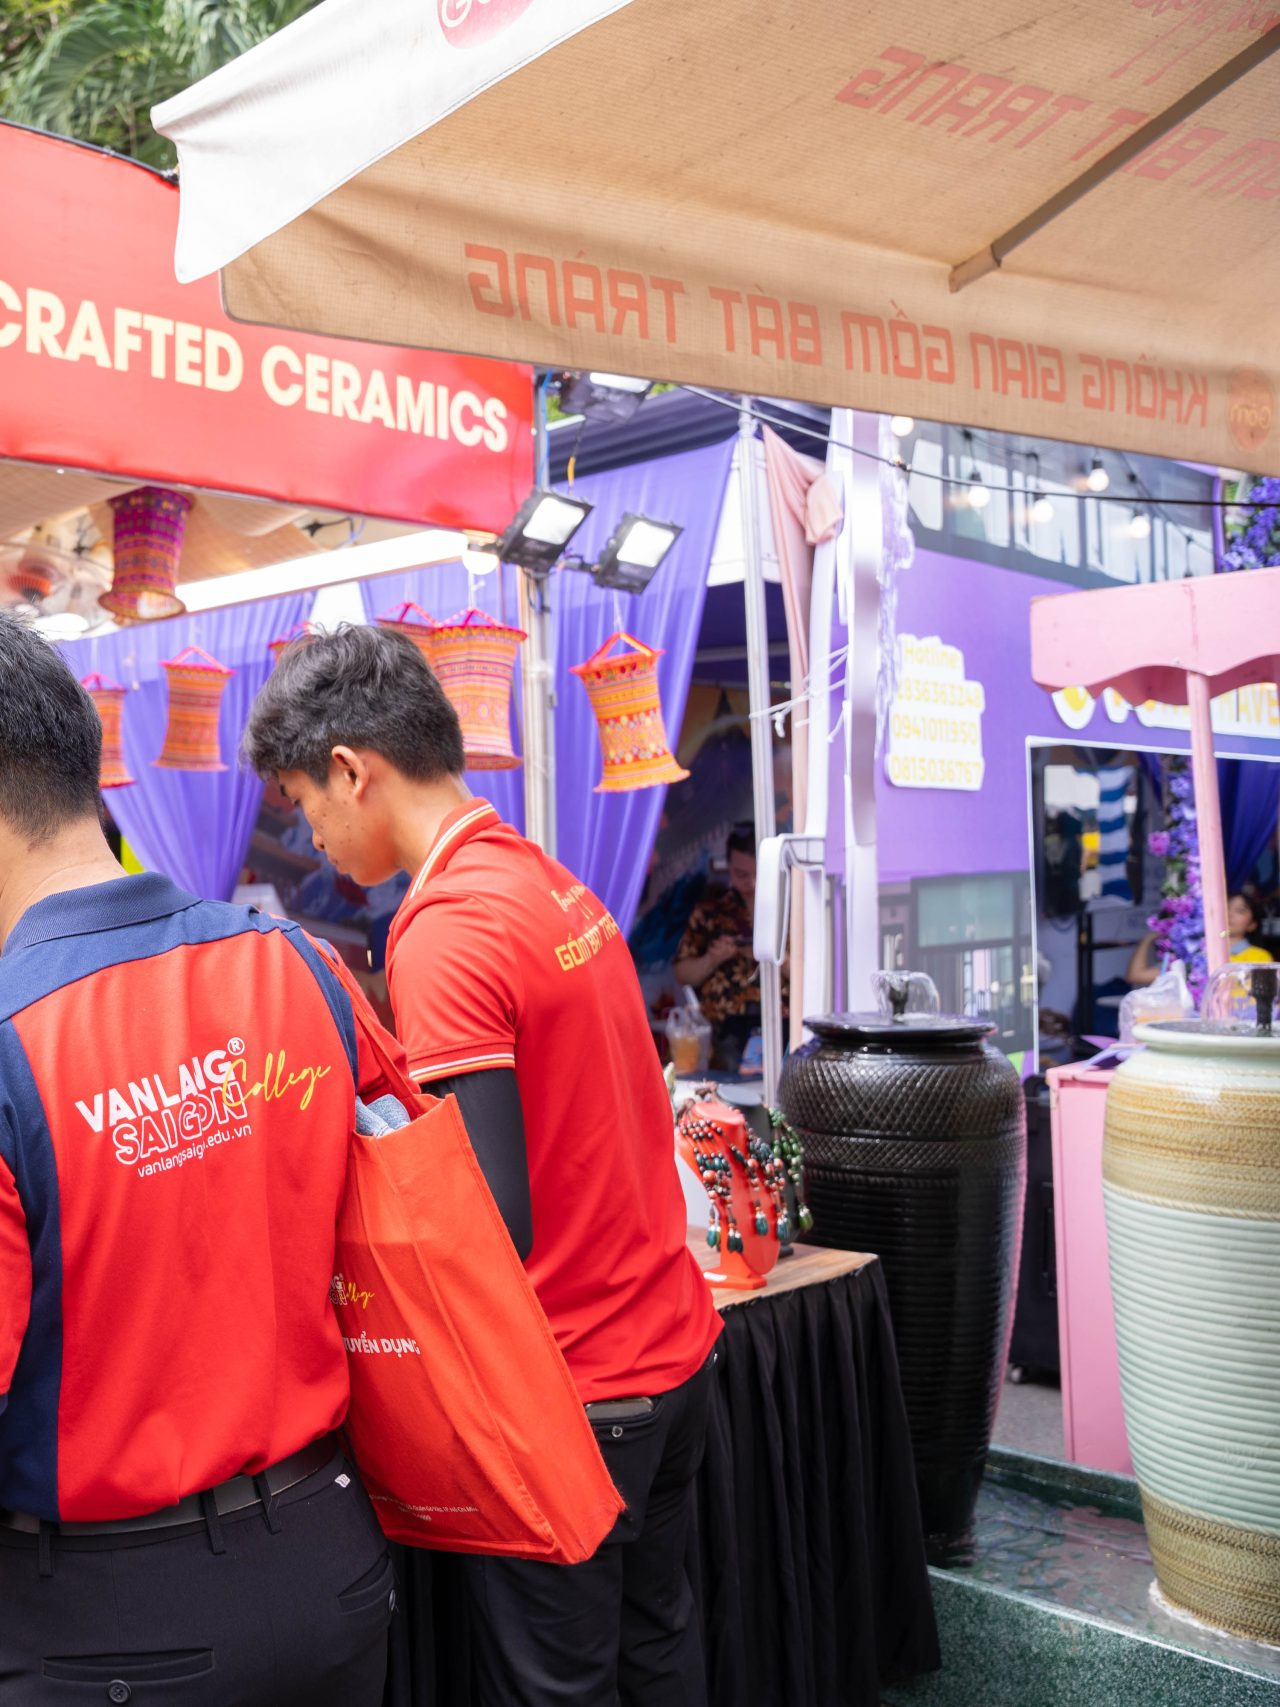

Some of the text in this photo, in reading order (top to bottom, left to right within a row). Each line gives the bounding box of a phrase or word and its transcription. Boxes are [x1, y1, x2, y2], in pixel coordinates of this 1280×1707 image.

[261, 345, 508, 454] CERAMICS
[221, 1049, 332, 1111] College
[137, 1123, 253, 1178] vanlangsaig.edu.vn
